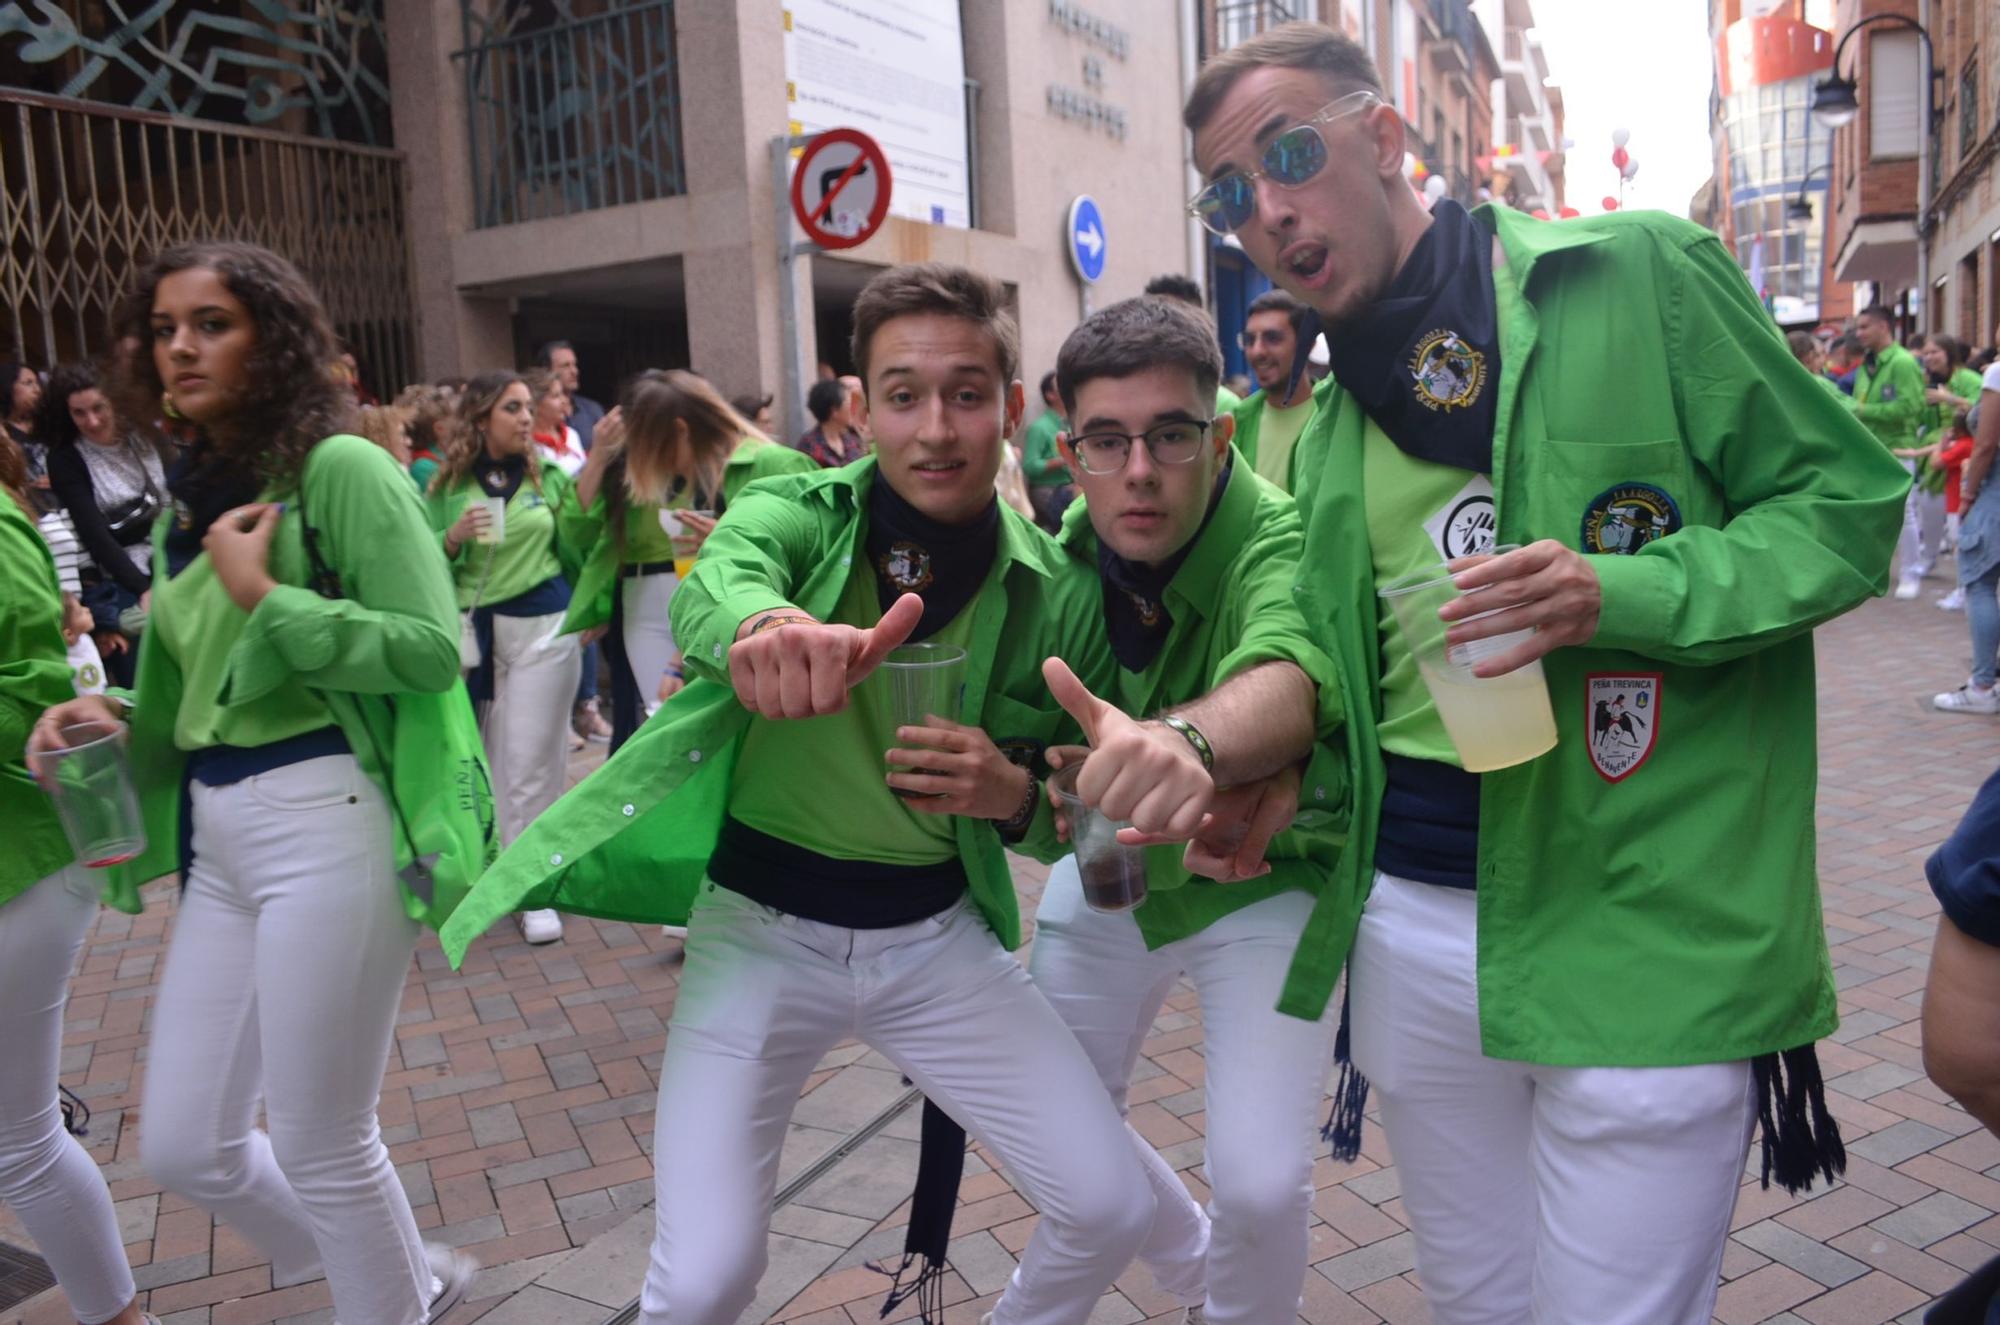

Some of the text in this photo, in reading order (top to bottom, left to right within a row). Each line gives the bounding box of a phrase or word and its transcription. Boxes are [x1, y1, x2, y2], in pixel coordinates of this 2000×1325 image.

[1592, 678, 1652, 689] PEÑA TREVINCA
[1596, 751, 1638, 774] BENAVENTE
